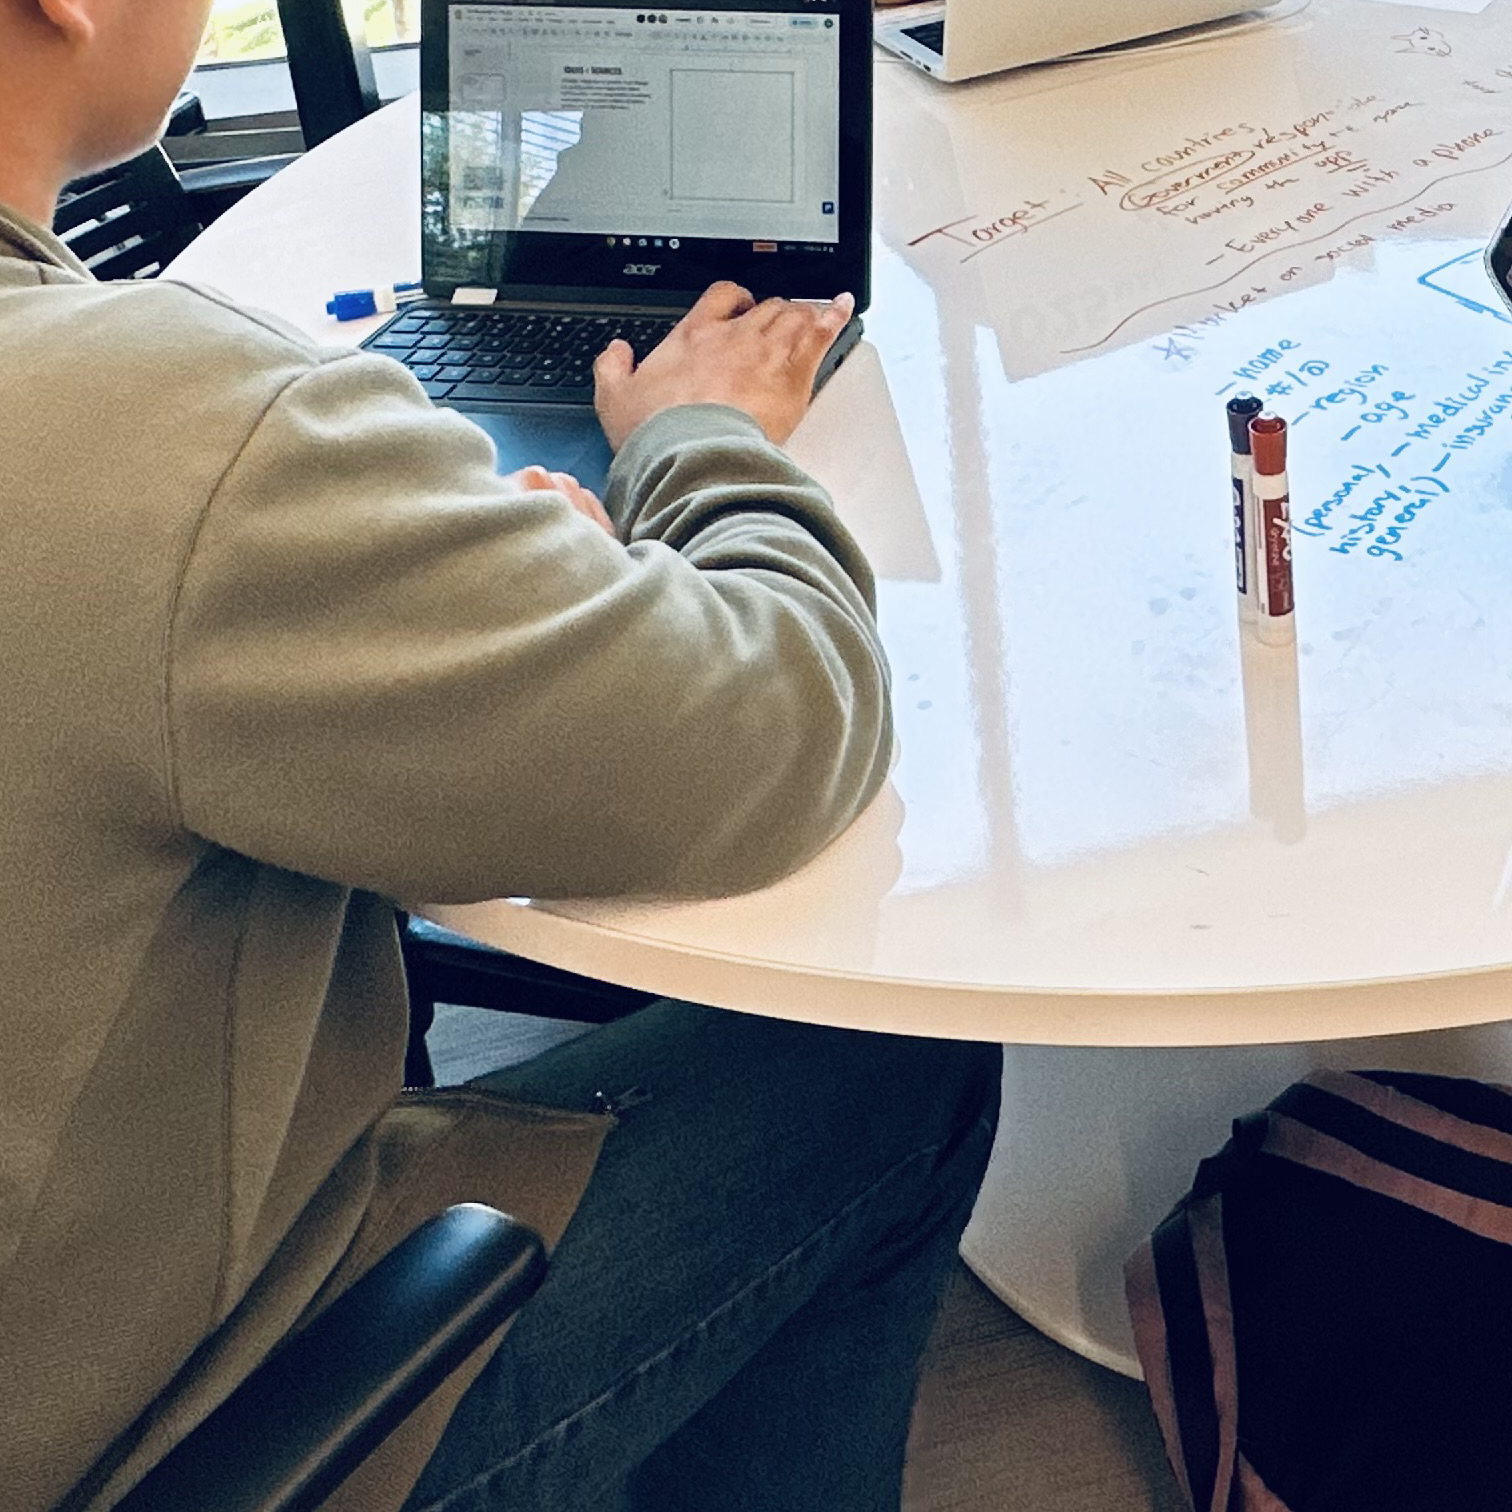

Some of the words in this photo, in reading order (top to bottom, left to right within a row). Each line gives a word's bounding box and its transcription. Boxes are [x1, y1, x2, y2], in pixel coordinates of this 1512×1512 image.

[1141, 121, 1255, 173] countries
[1156, 196, 1197, 217] for
[1234, 336, 1302, 382] name
[1309, 362, 1390, 410] region
[1360, 390, 1417, 420] age
[1405, 372, 1490, 440] medical
